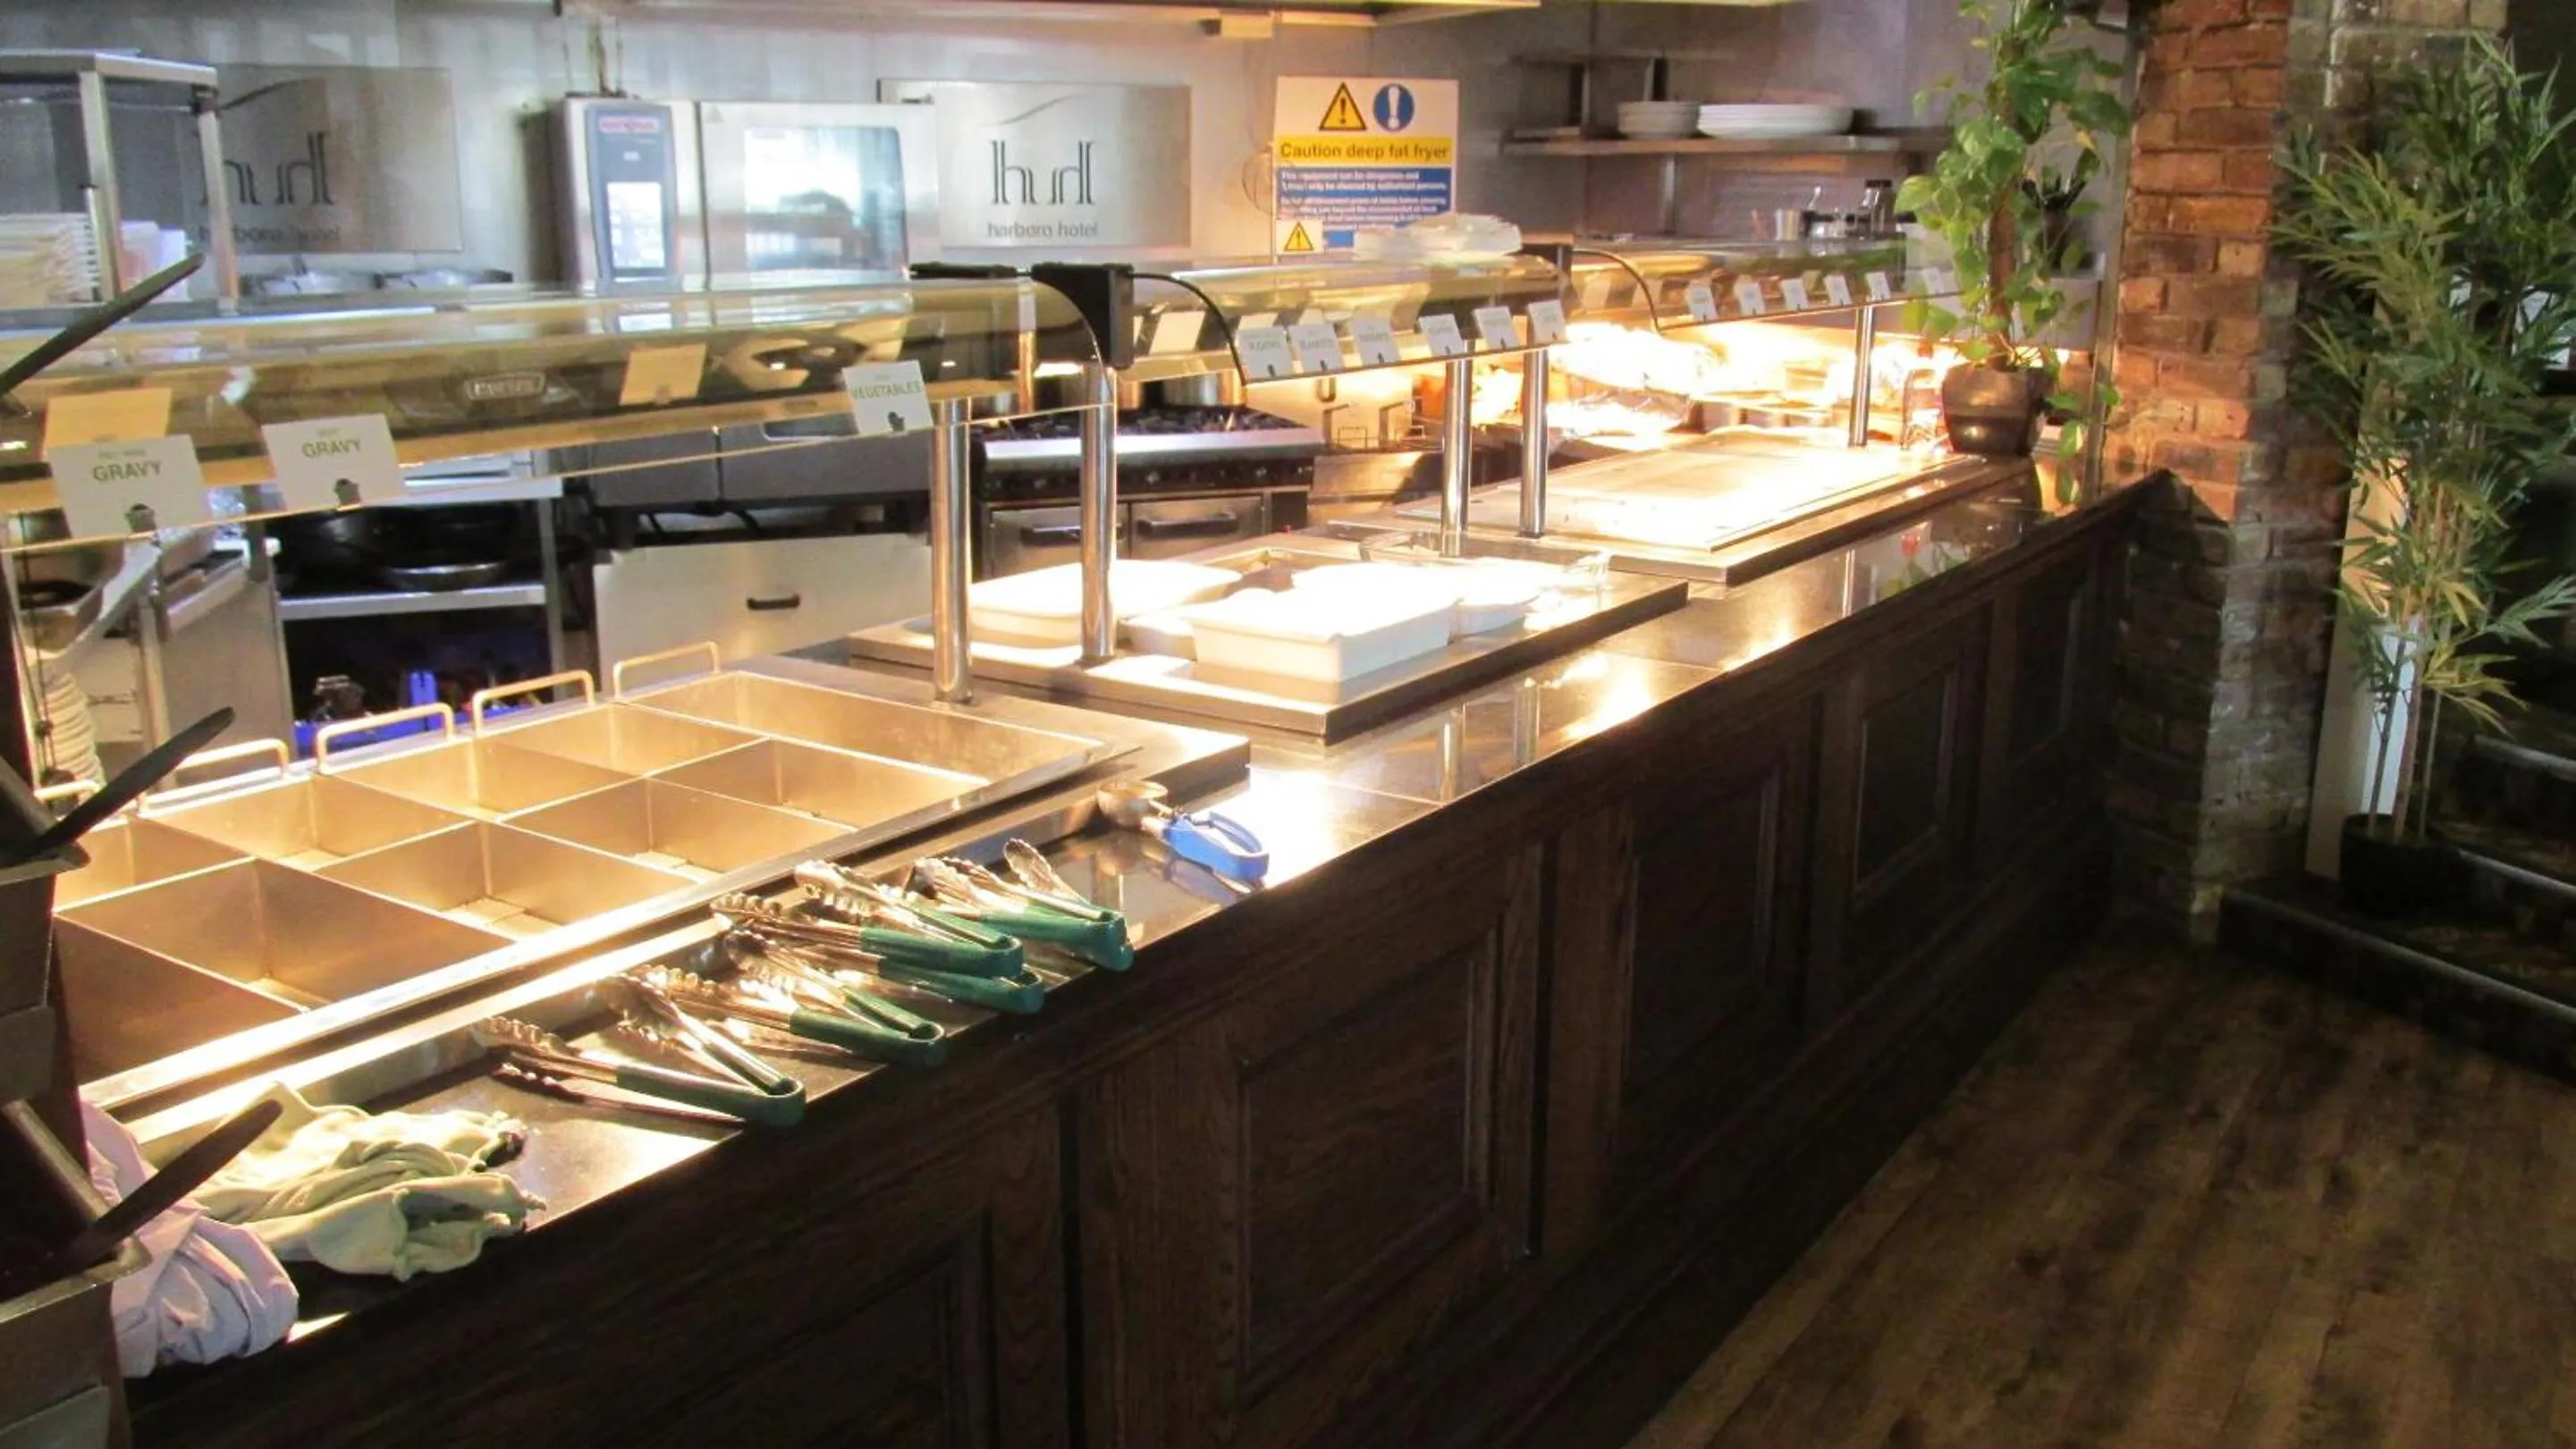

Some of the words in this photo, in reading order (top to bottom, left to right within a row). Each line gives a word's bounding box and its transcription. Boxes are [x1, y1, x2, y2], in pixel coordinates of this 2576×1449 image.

[1280, 142, 1342, 158] Caution
[1346, 143, 1385, 160] deep
[1389, 143, 1409, 158] fat
[1415, 143, 1448, 161] fryer
[987, 222, 1052, 238] harboro
[1058, 222, 1098, 237] hotel
[852, 380, 921, 399] VEGETABLES
[301, 437, 360, 459] GRAVY
[92, 459, 162, 482] GRAVY
